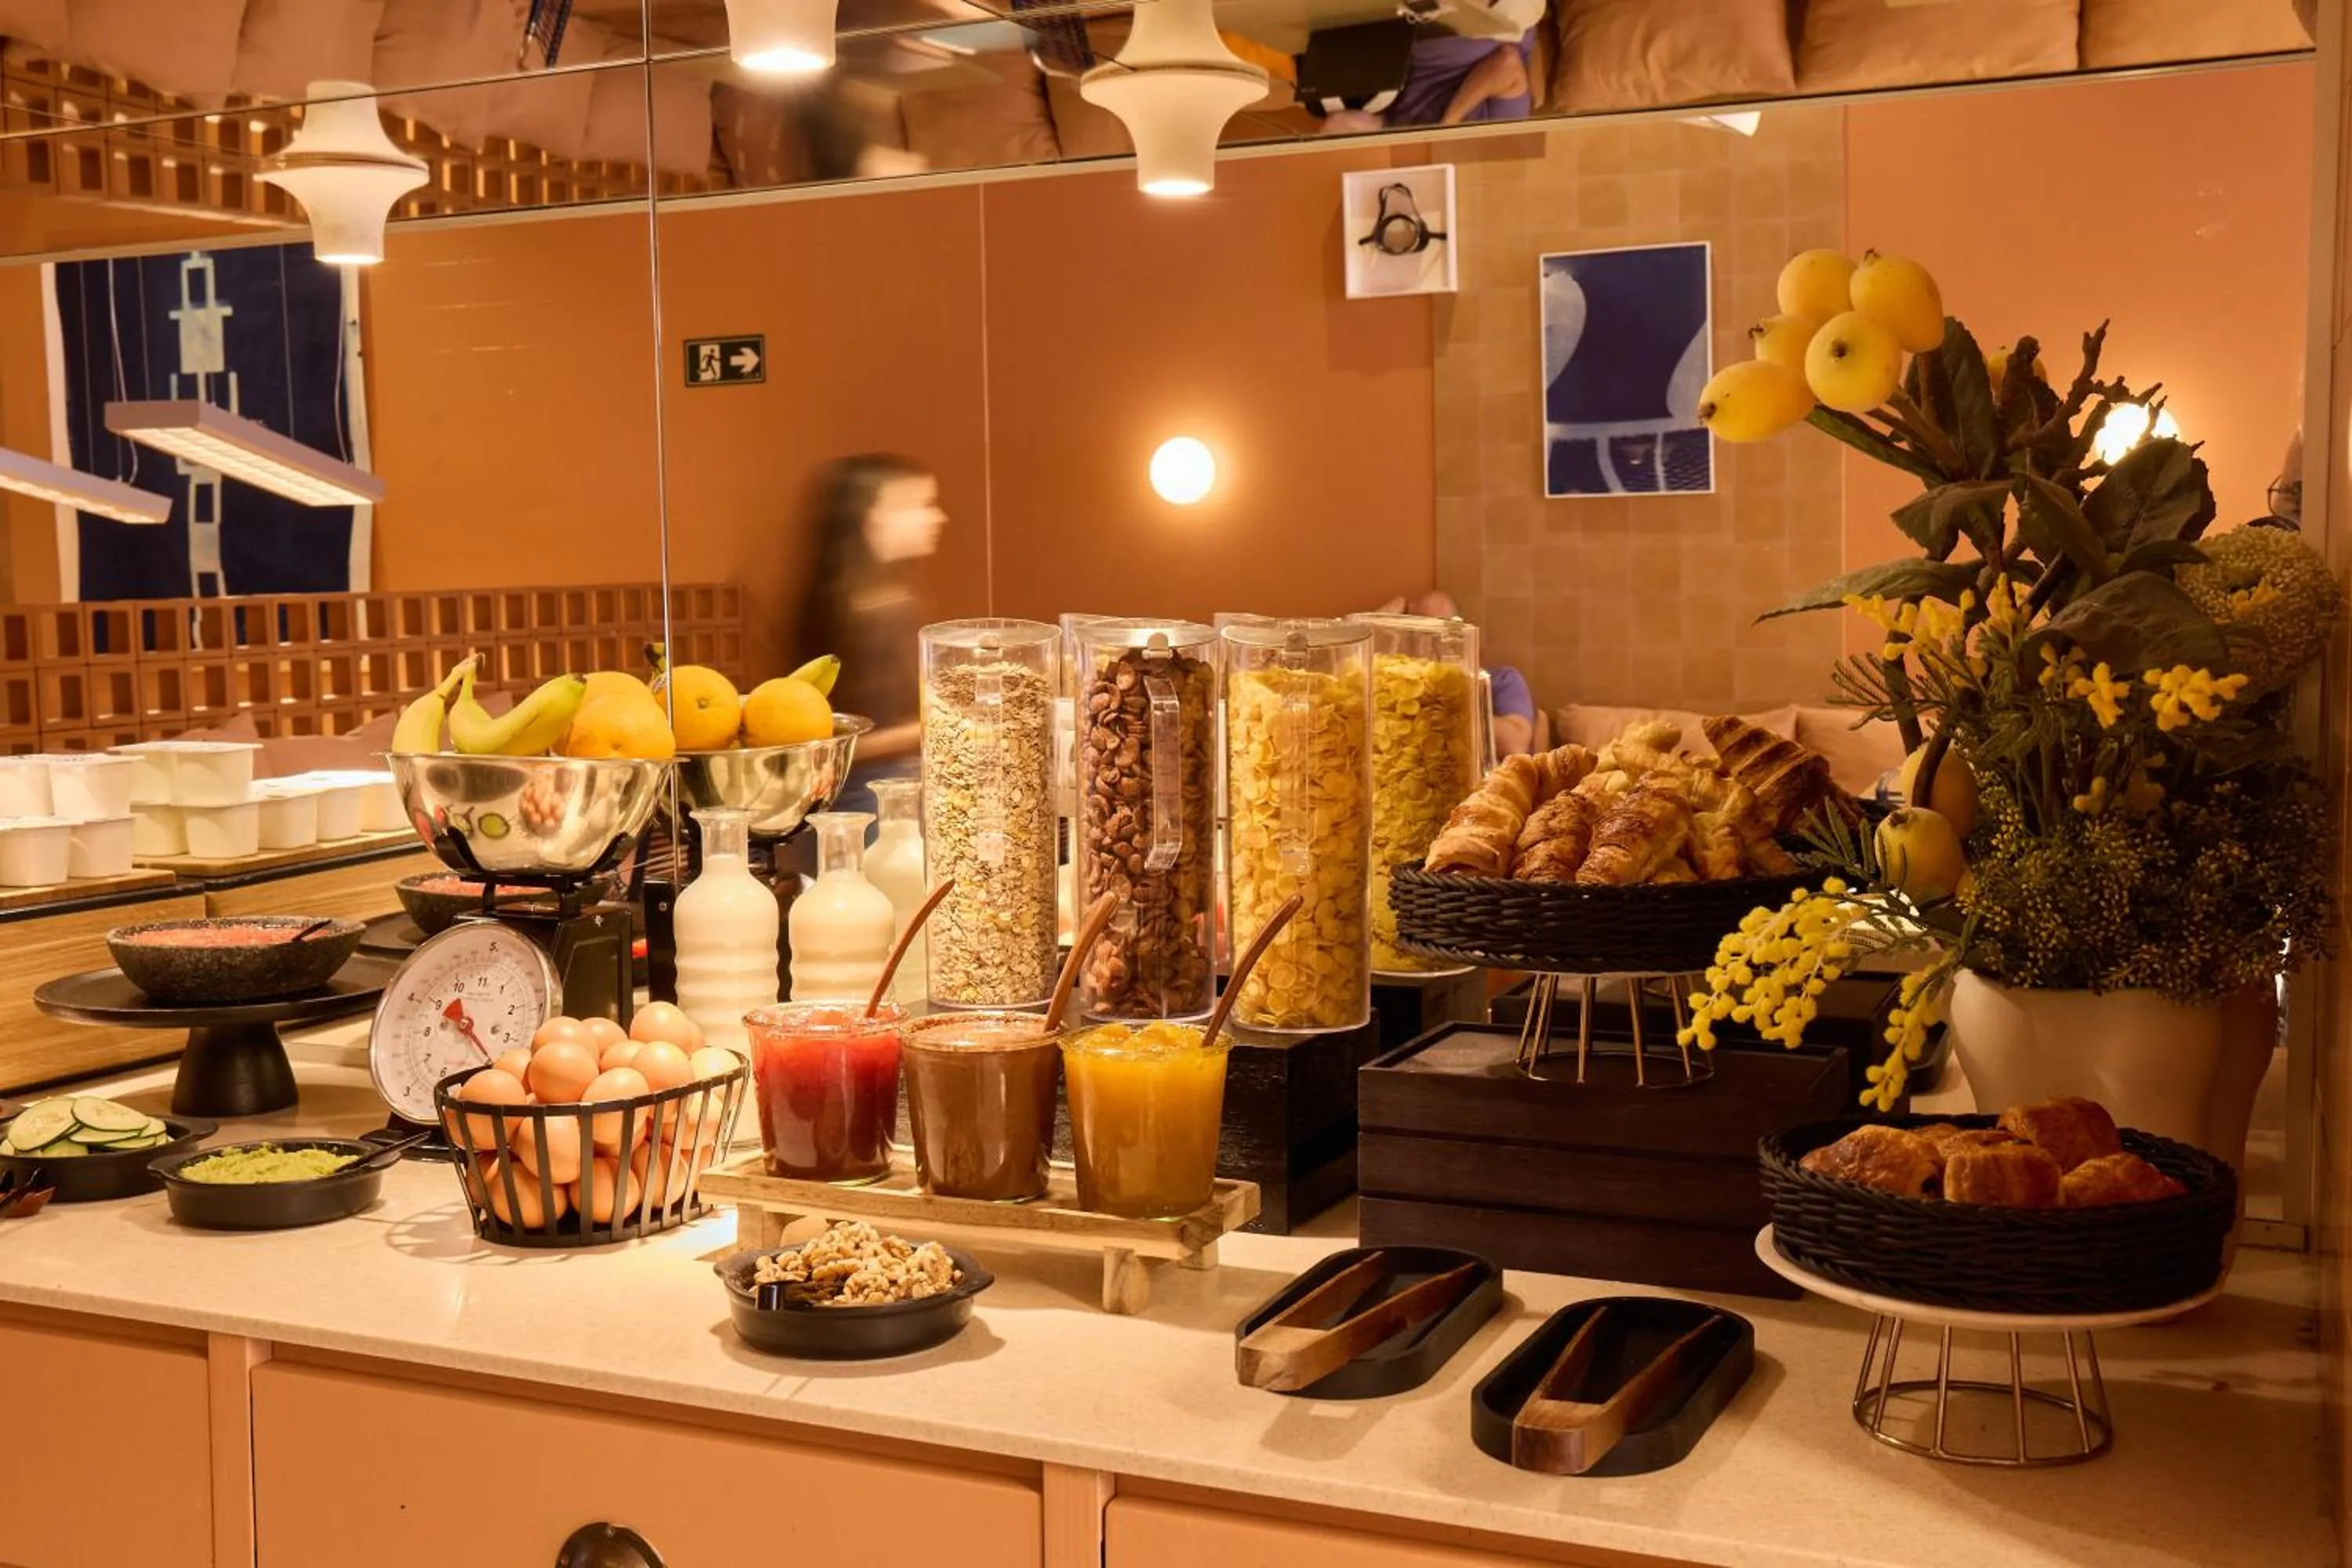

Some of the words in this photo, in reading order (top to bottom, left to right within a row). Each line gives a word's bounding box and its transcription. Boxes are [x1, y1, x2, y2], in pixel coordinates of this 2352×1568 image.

[477, 976, 488, 987] 11
[453, 982, 465, 993] 10
[499, 984, 505, 996] 1
[435, 1000, 443, 1011] 9
[507, 1004, 515, 1015] 2
[503, 1033, 510, 1044] 3
[423, 1053, 432, 1064] 7
[440, 1067, 448, 1077] 6
